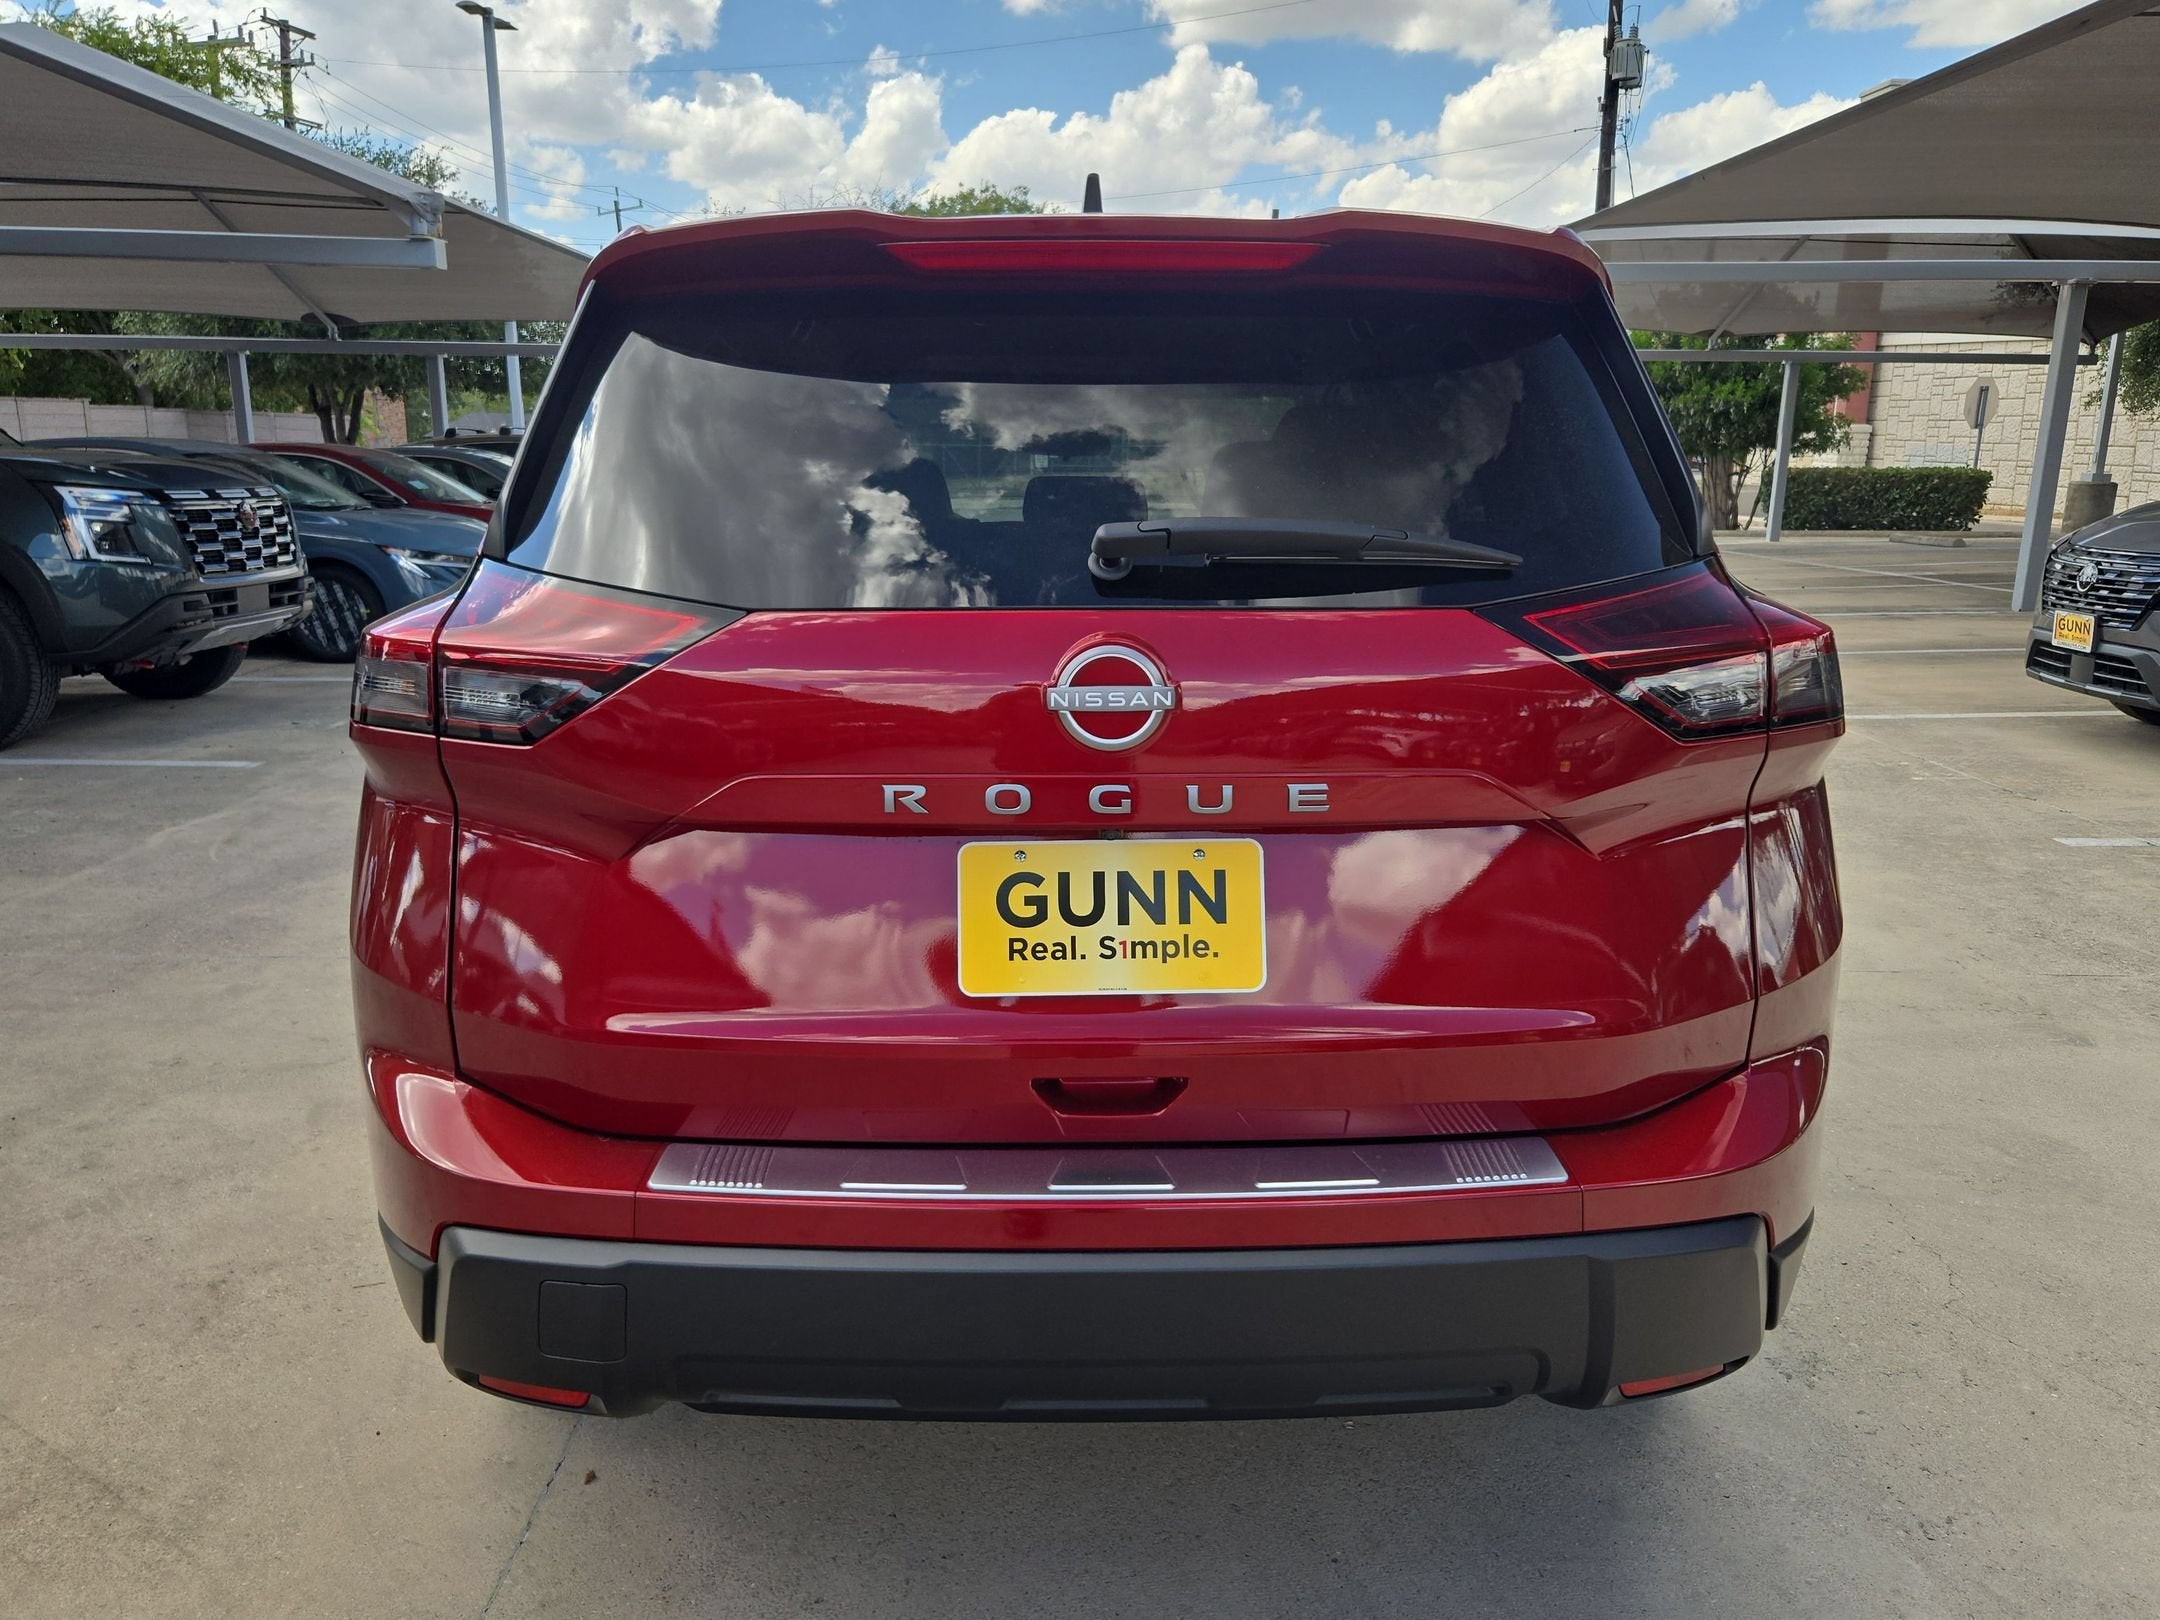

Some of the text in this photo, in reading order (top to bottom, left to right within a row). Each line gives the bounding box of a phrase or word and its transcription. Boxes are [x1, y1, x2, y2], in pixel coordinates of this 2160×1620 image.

[2058, 618, 2091, 636] GUNN
[1050, 691, 1172, 707] NISSAN
[882, 783, 1330, 814] ROGUE
[995, 869, 1228, 929] GUNN
[1008, 933, 1219, 964] Real. S1mple.
